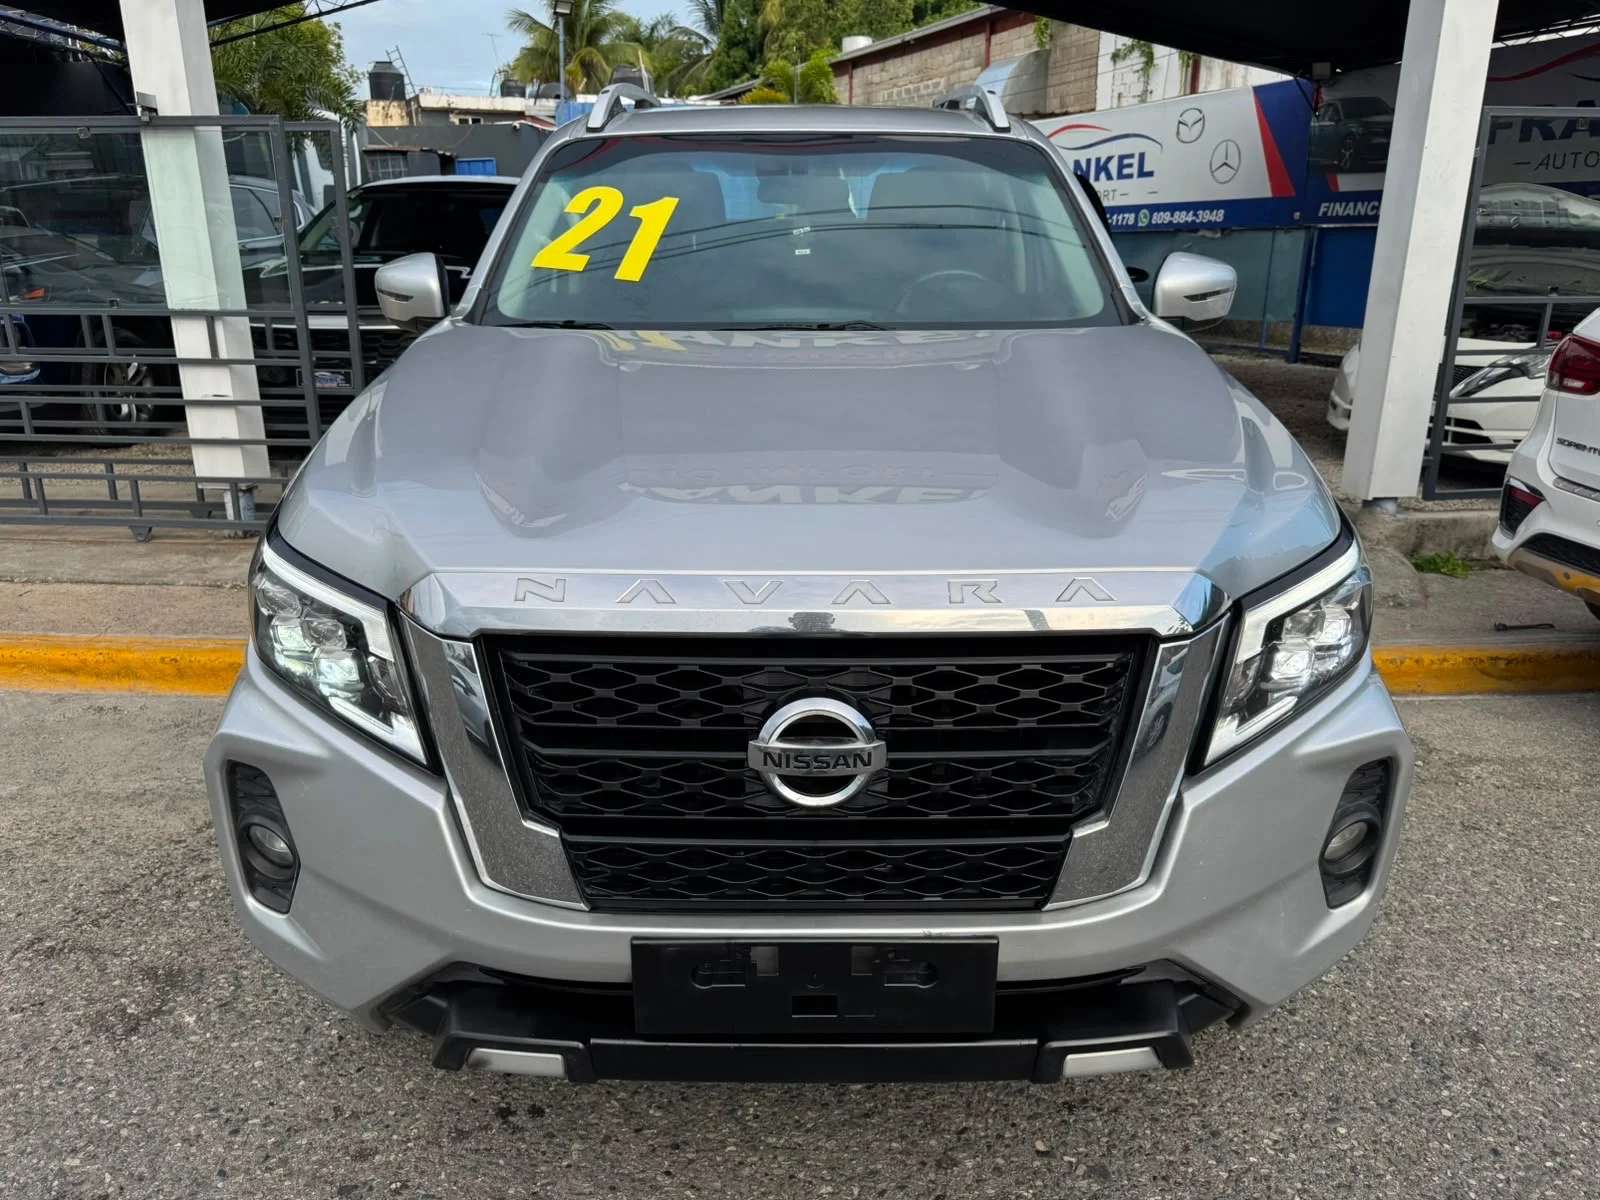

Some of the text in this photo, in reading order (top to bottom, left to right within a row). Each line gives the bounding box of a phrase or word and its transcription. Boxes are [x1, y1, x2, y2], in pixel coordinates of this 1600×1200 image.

[1534, 150, 1600, 171] AUTO
[1318, 201, 1381, 217] FINANC
[1107, 213, 1136, 226] -1178
[530, 185, 680, 282] 21
[513, 576, 1117, 605] NAVARA
[763, 751, 873, 770] NISSAN
